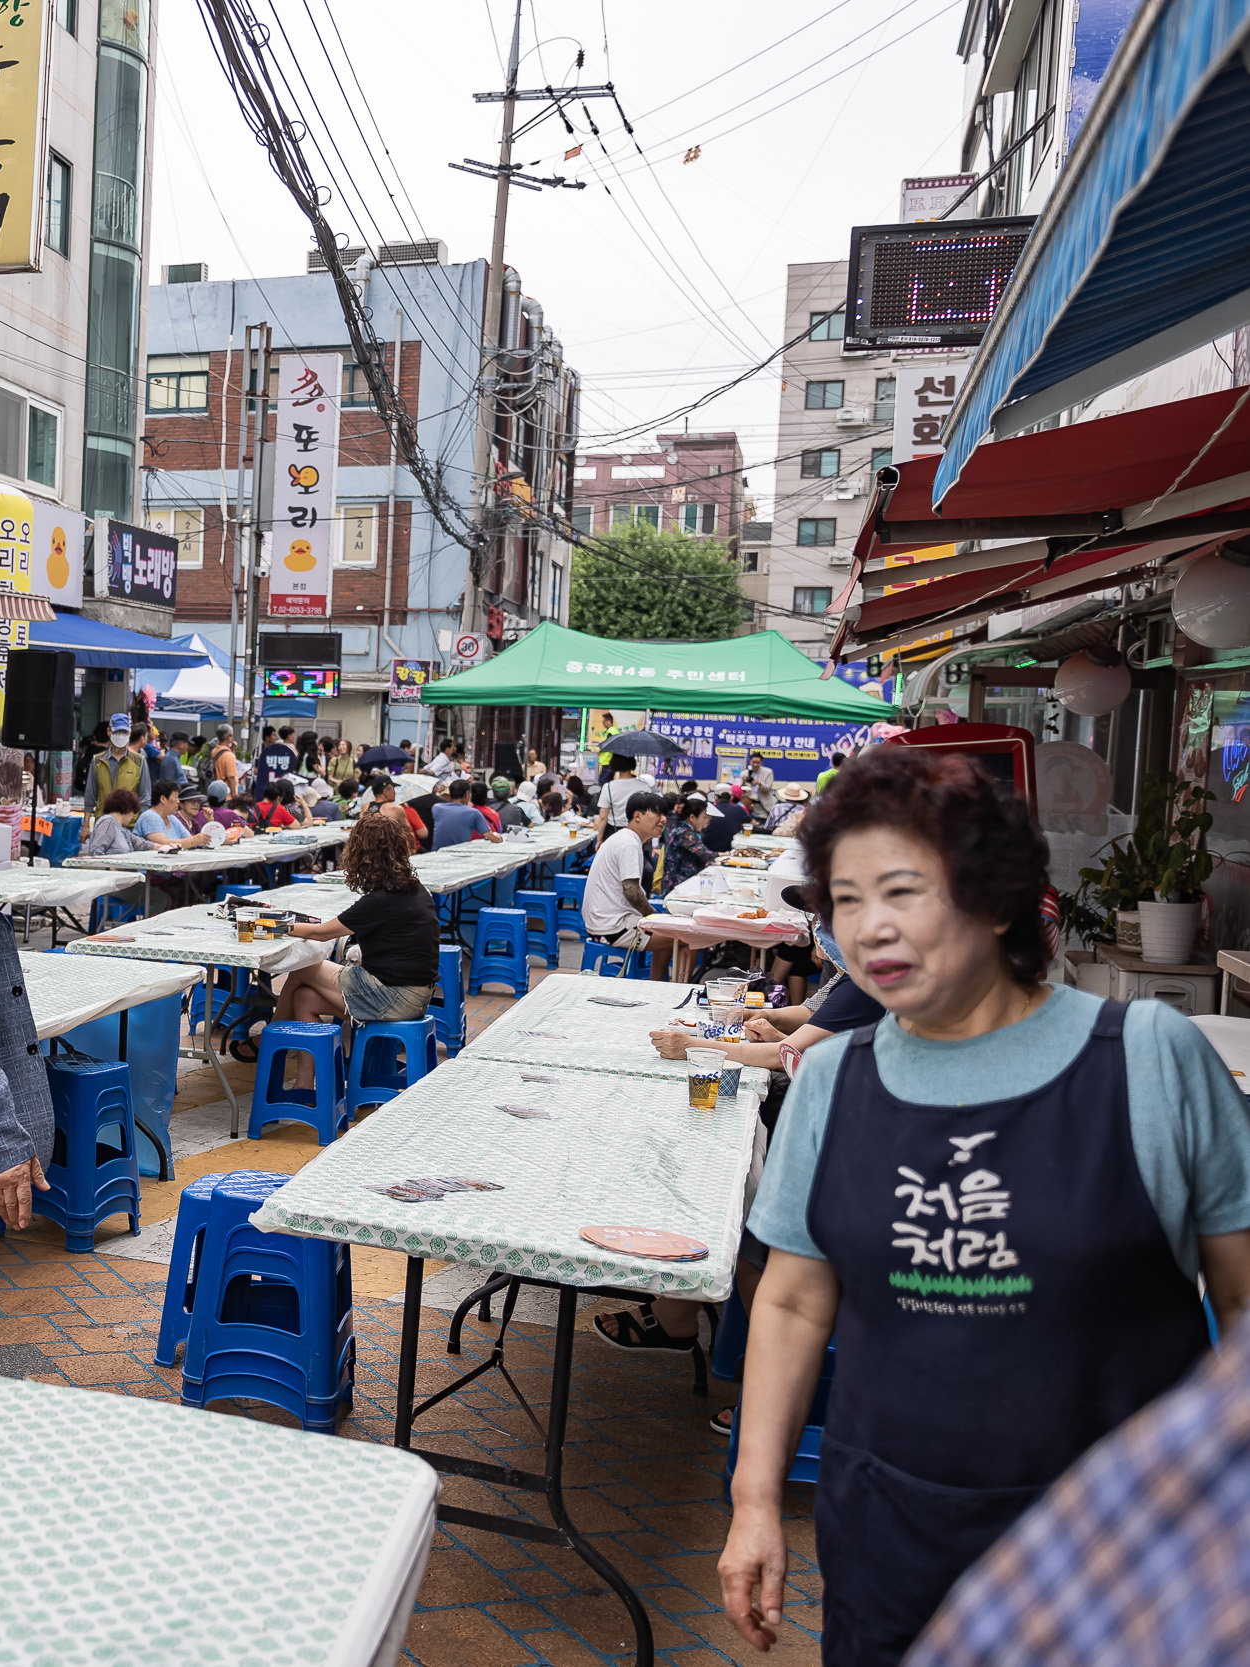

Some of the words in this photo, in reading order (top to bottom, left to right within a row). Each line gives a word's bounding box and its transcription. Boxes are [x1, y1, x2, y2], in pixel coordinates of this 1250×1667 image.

[134, 543, 175, 599] 노래방
[269, 669, 334, 695] 오리
[565, 661, 656, 678] 중곡제4동
[666, 669, 746, 682] 주민센터
[266, 755, 290, 770] 빅뱅
[894, 1165, 1011, 1225] 처음
[891, 1220, 1020, 1273] 처럼
